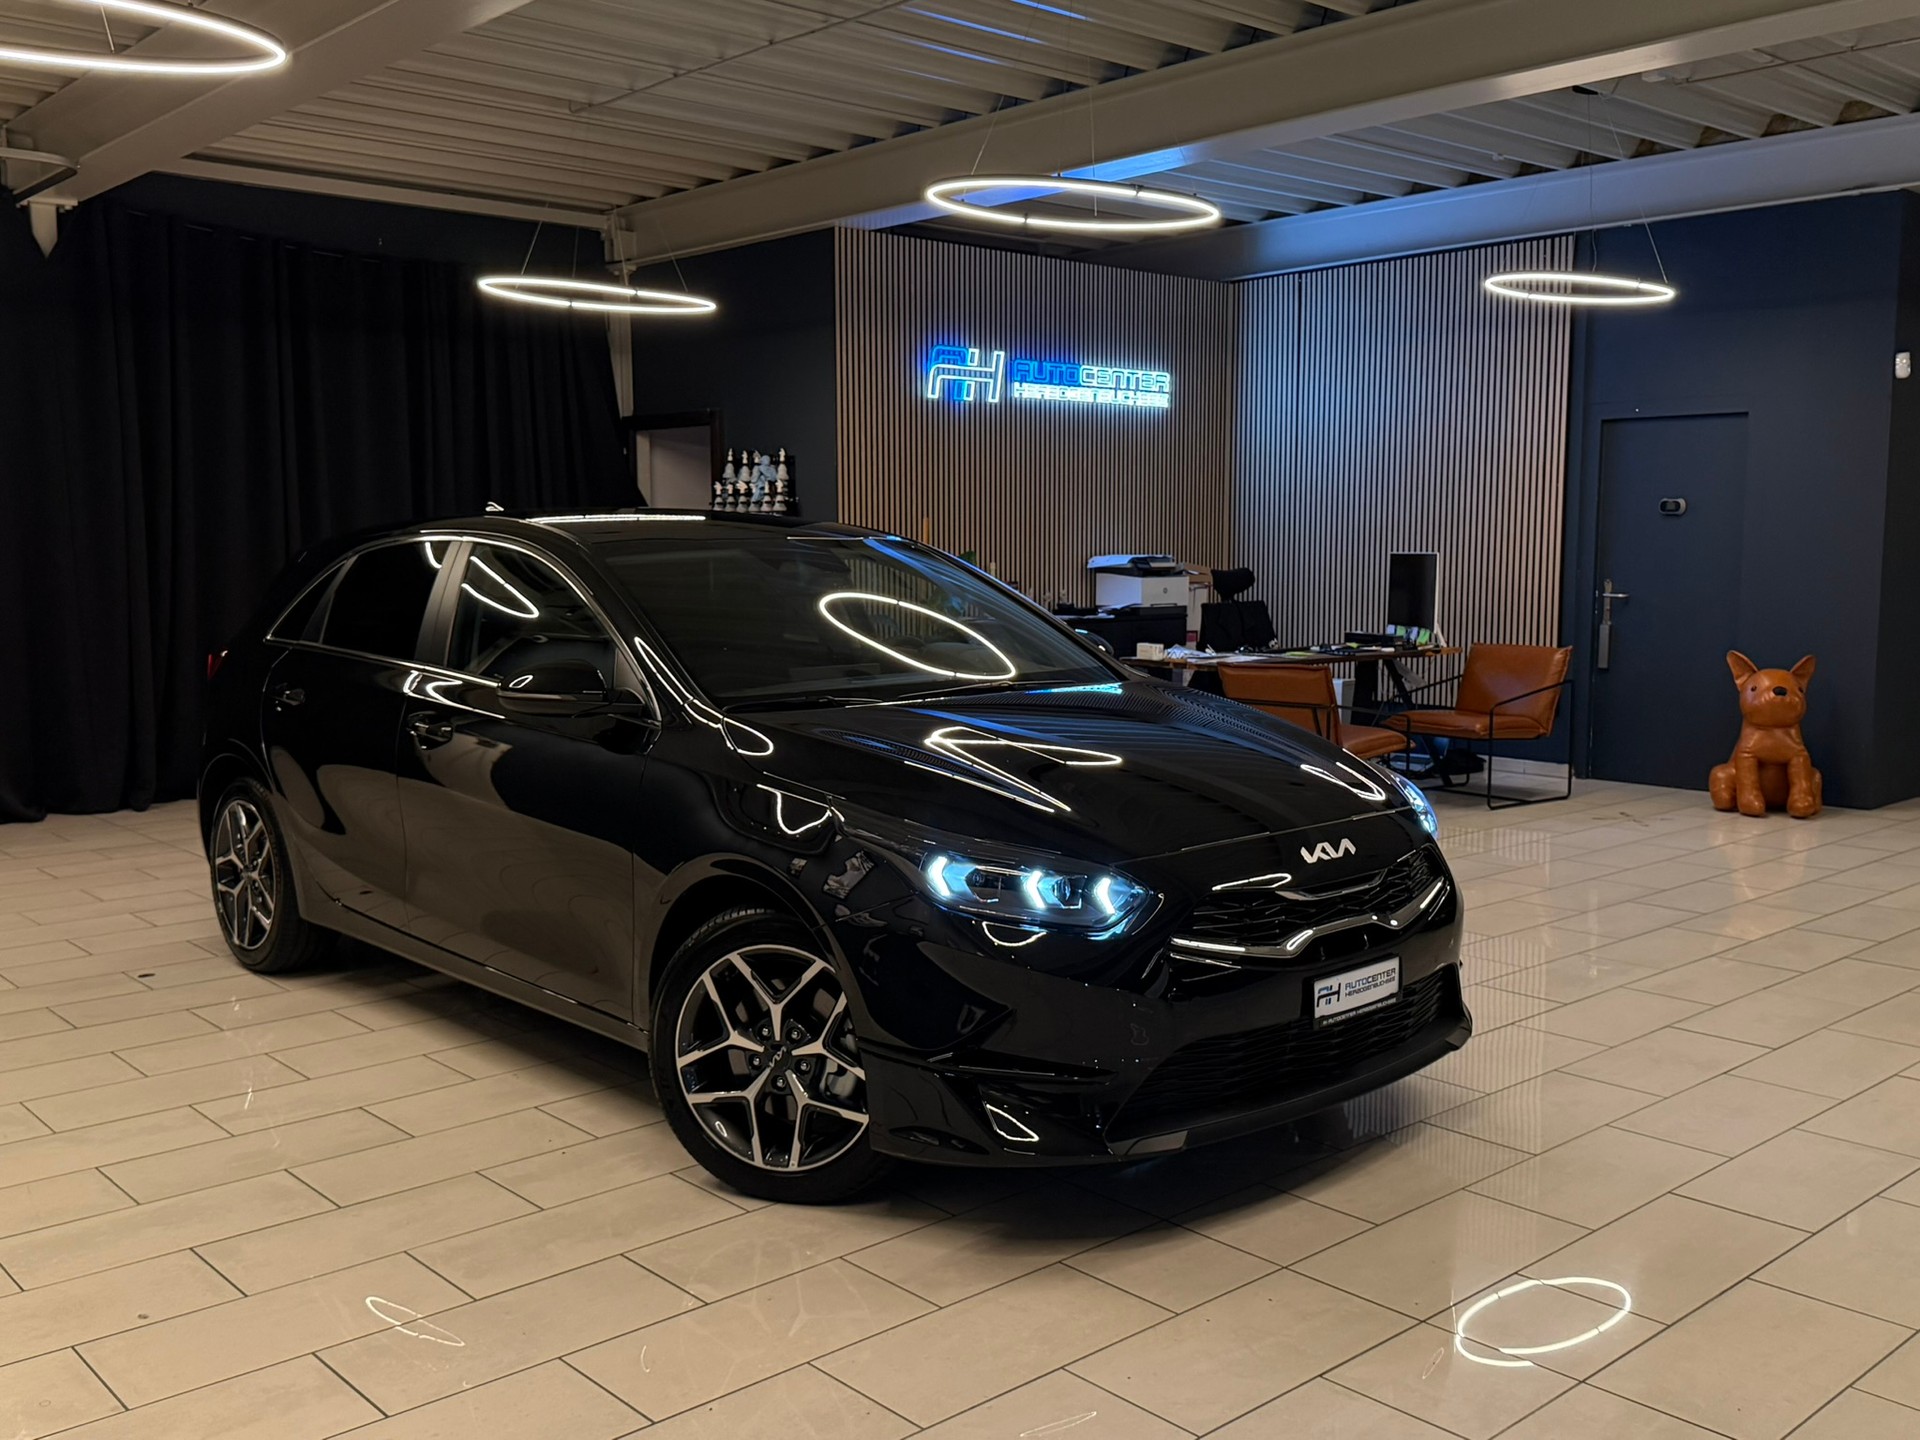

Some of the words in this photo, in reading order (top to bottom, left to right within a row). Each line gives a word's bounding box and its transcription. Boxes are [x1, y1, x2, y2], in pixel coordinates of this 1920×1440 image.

[1013, 359, 1171, 392] AUTOCENTER
[1300, 838, 1357, 863] KIA
[1345, 968, 1396, 991] AUTOCENTER
